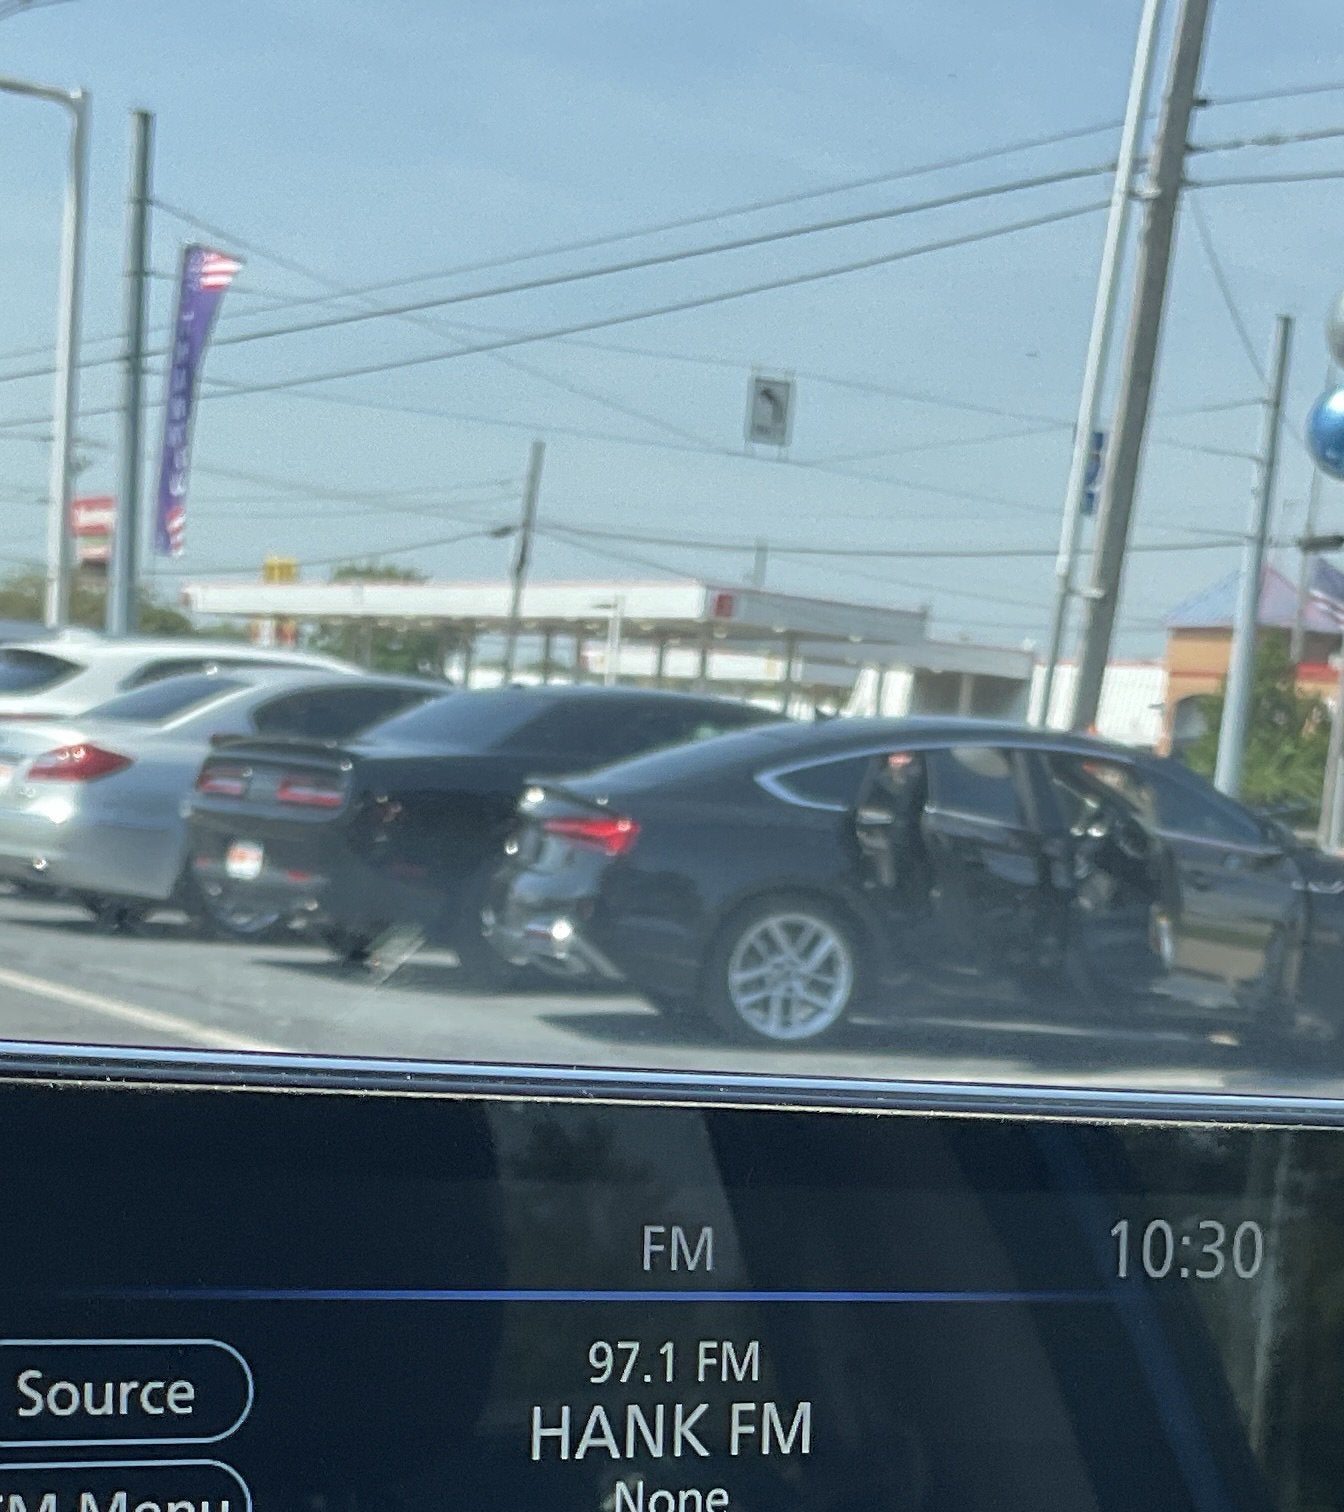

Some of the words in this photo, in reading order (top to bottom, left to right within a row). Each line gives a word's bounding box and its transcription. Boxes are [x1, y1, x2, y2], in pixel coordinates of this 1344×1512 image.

[642, 1225, 714, 1271] FM
[1110, 1219, 1264, 1279] 10:30
[588, 1340, 675, 1384] 97.1
[697, 1340, 760, 1382] FM
[16, 1368, 196, 1417] Source
[531, 1403, 710, 1460] HANK
[729, 1401, 812, 1456] FM
